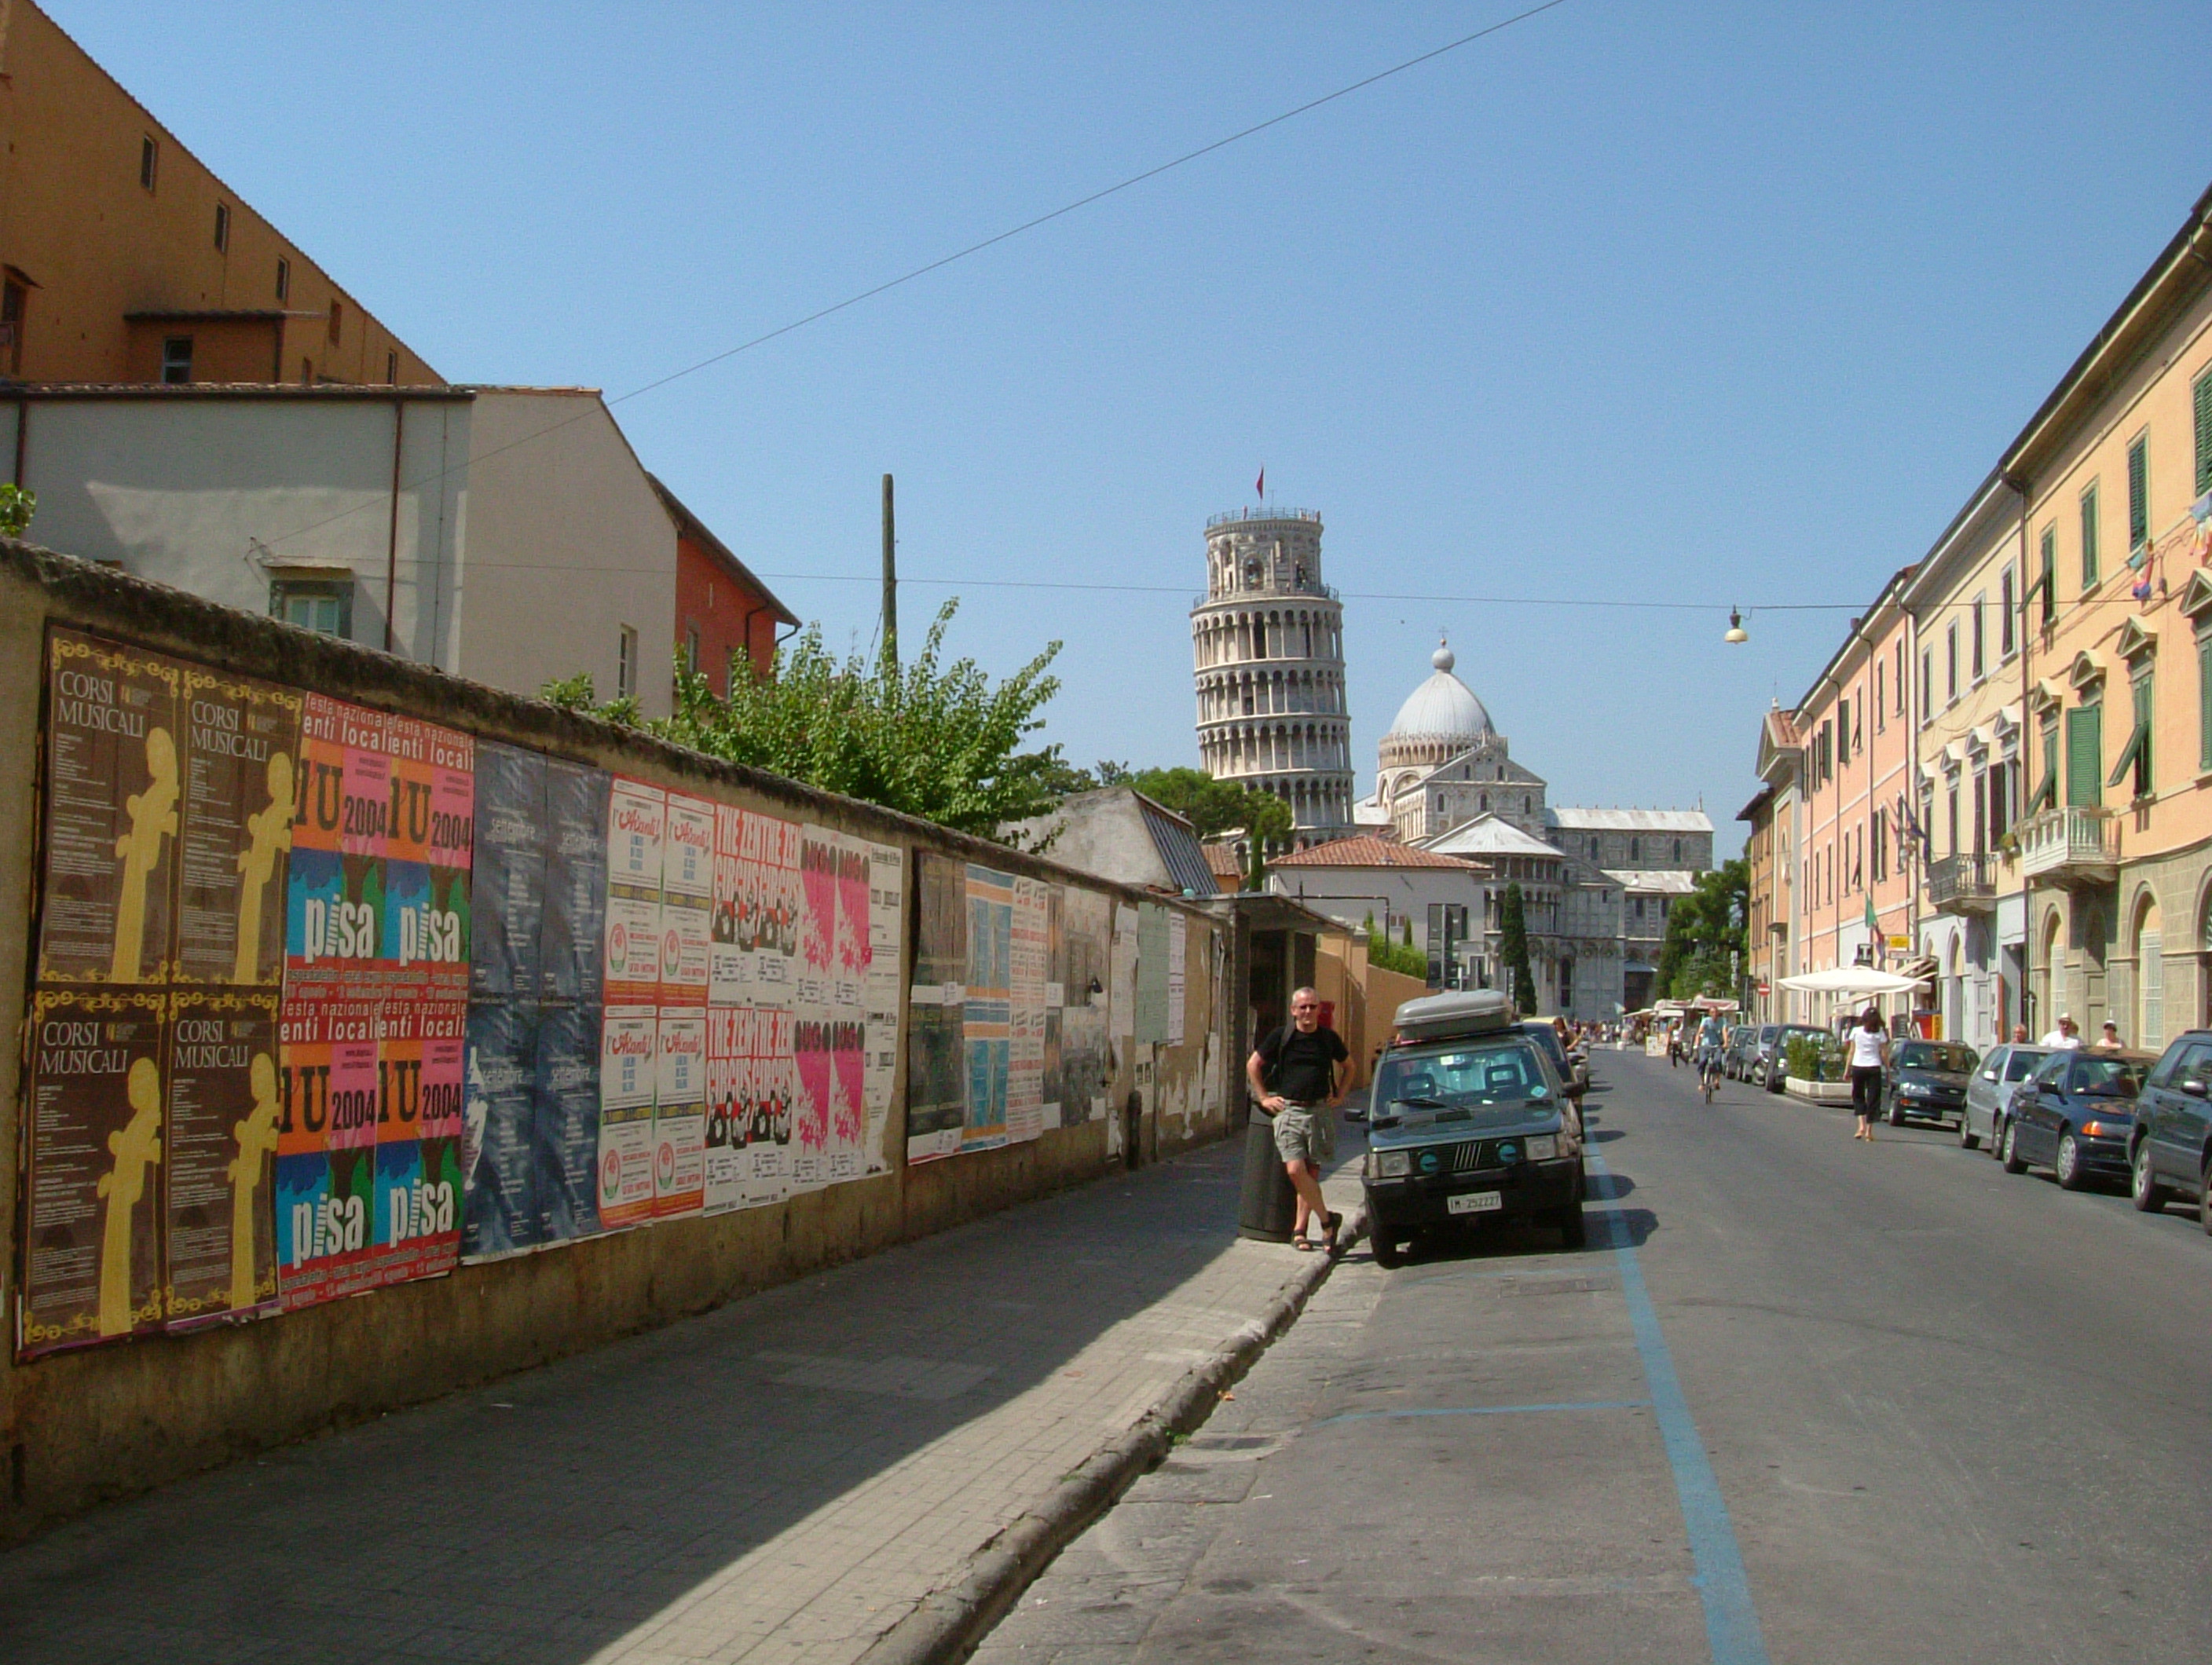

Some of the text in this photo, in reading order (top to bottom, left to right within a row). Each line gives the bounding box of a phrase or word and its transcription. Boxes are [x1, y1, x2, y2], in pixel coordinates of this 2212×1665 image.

[60, 670, 114, 704] CORSI
[57, 699, 144, 738] MUSICALI
[192, 701, 239, 731] CORSI
[337, 704, 393, 730] nazionale
[191, 725, 268, 762] MUSICALI
[303, 715, 335, 740] enti
[342, 720, 393, 752] locali
[425, 726, 474, 748] nazionale
[393, 737, 474, 772] enti locali
[344, 795, 387, 839] 2004
[431, 811, 471, 852] 2004
[305, 893, 375, 964] pisa
[399, 902, 460, 967] pisa
[321, 1001, 379, 1016] nazionale
[415, 999, 467, 1015] nazionale
[42, 1022, 99, 1047] CORSI
[176, 1019, 224, 1043] CORSI
[280, 1017, 318, 1041] enti
[328, 1015, 379, 1040] locali
[379, 1014, 466, 1037] enti locali
[39, 1049, 128, 1075] MUSICALI
[174, 1045, 248, 1068] MUSICALI
[331, 1089, 376, 1130] 2004
[423, 1083, 460, 1121] 2004
[390, 1178, 453, 1249] pisa
[292, 1192, 365, 1270] pisa
